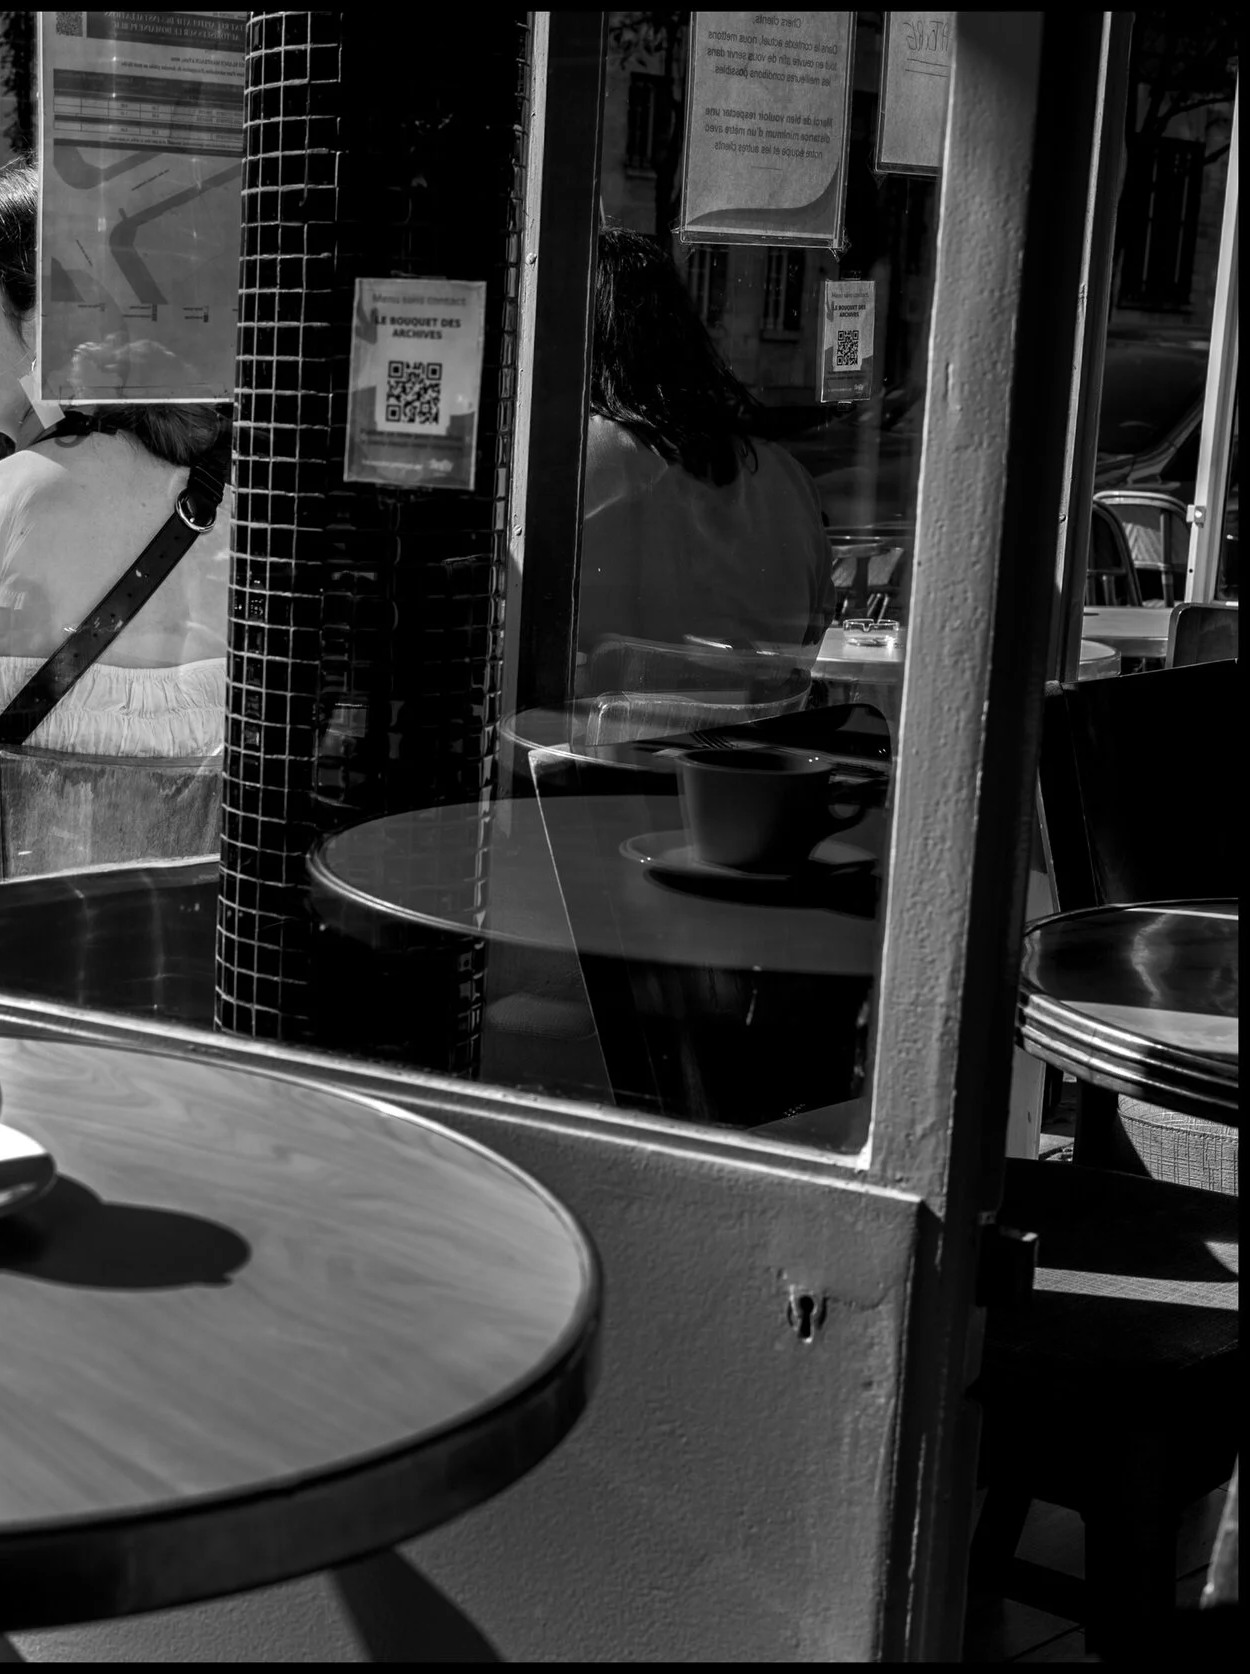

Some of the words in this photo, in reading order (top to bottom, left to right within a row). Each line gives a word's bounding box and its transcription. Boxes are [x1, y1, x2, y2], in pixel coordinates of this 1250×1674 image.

[372, 293, 400, 304] Menu
[402, 296, 425, 304] sans
[427, 296, 466, 306] contact
[375, 315, 386, 325] LE
[390, 317, 437, 327] BOUQUET
[441, 318, 461, 328] DES
[392, 329, 442, 339] ARCHIVES
